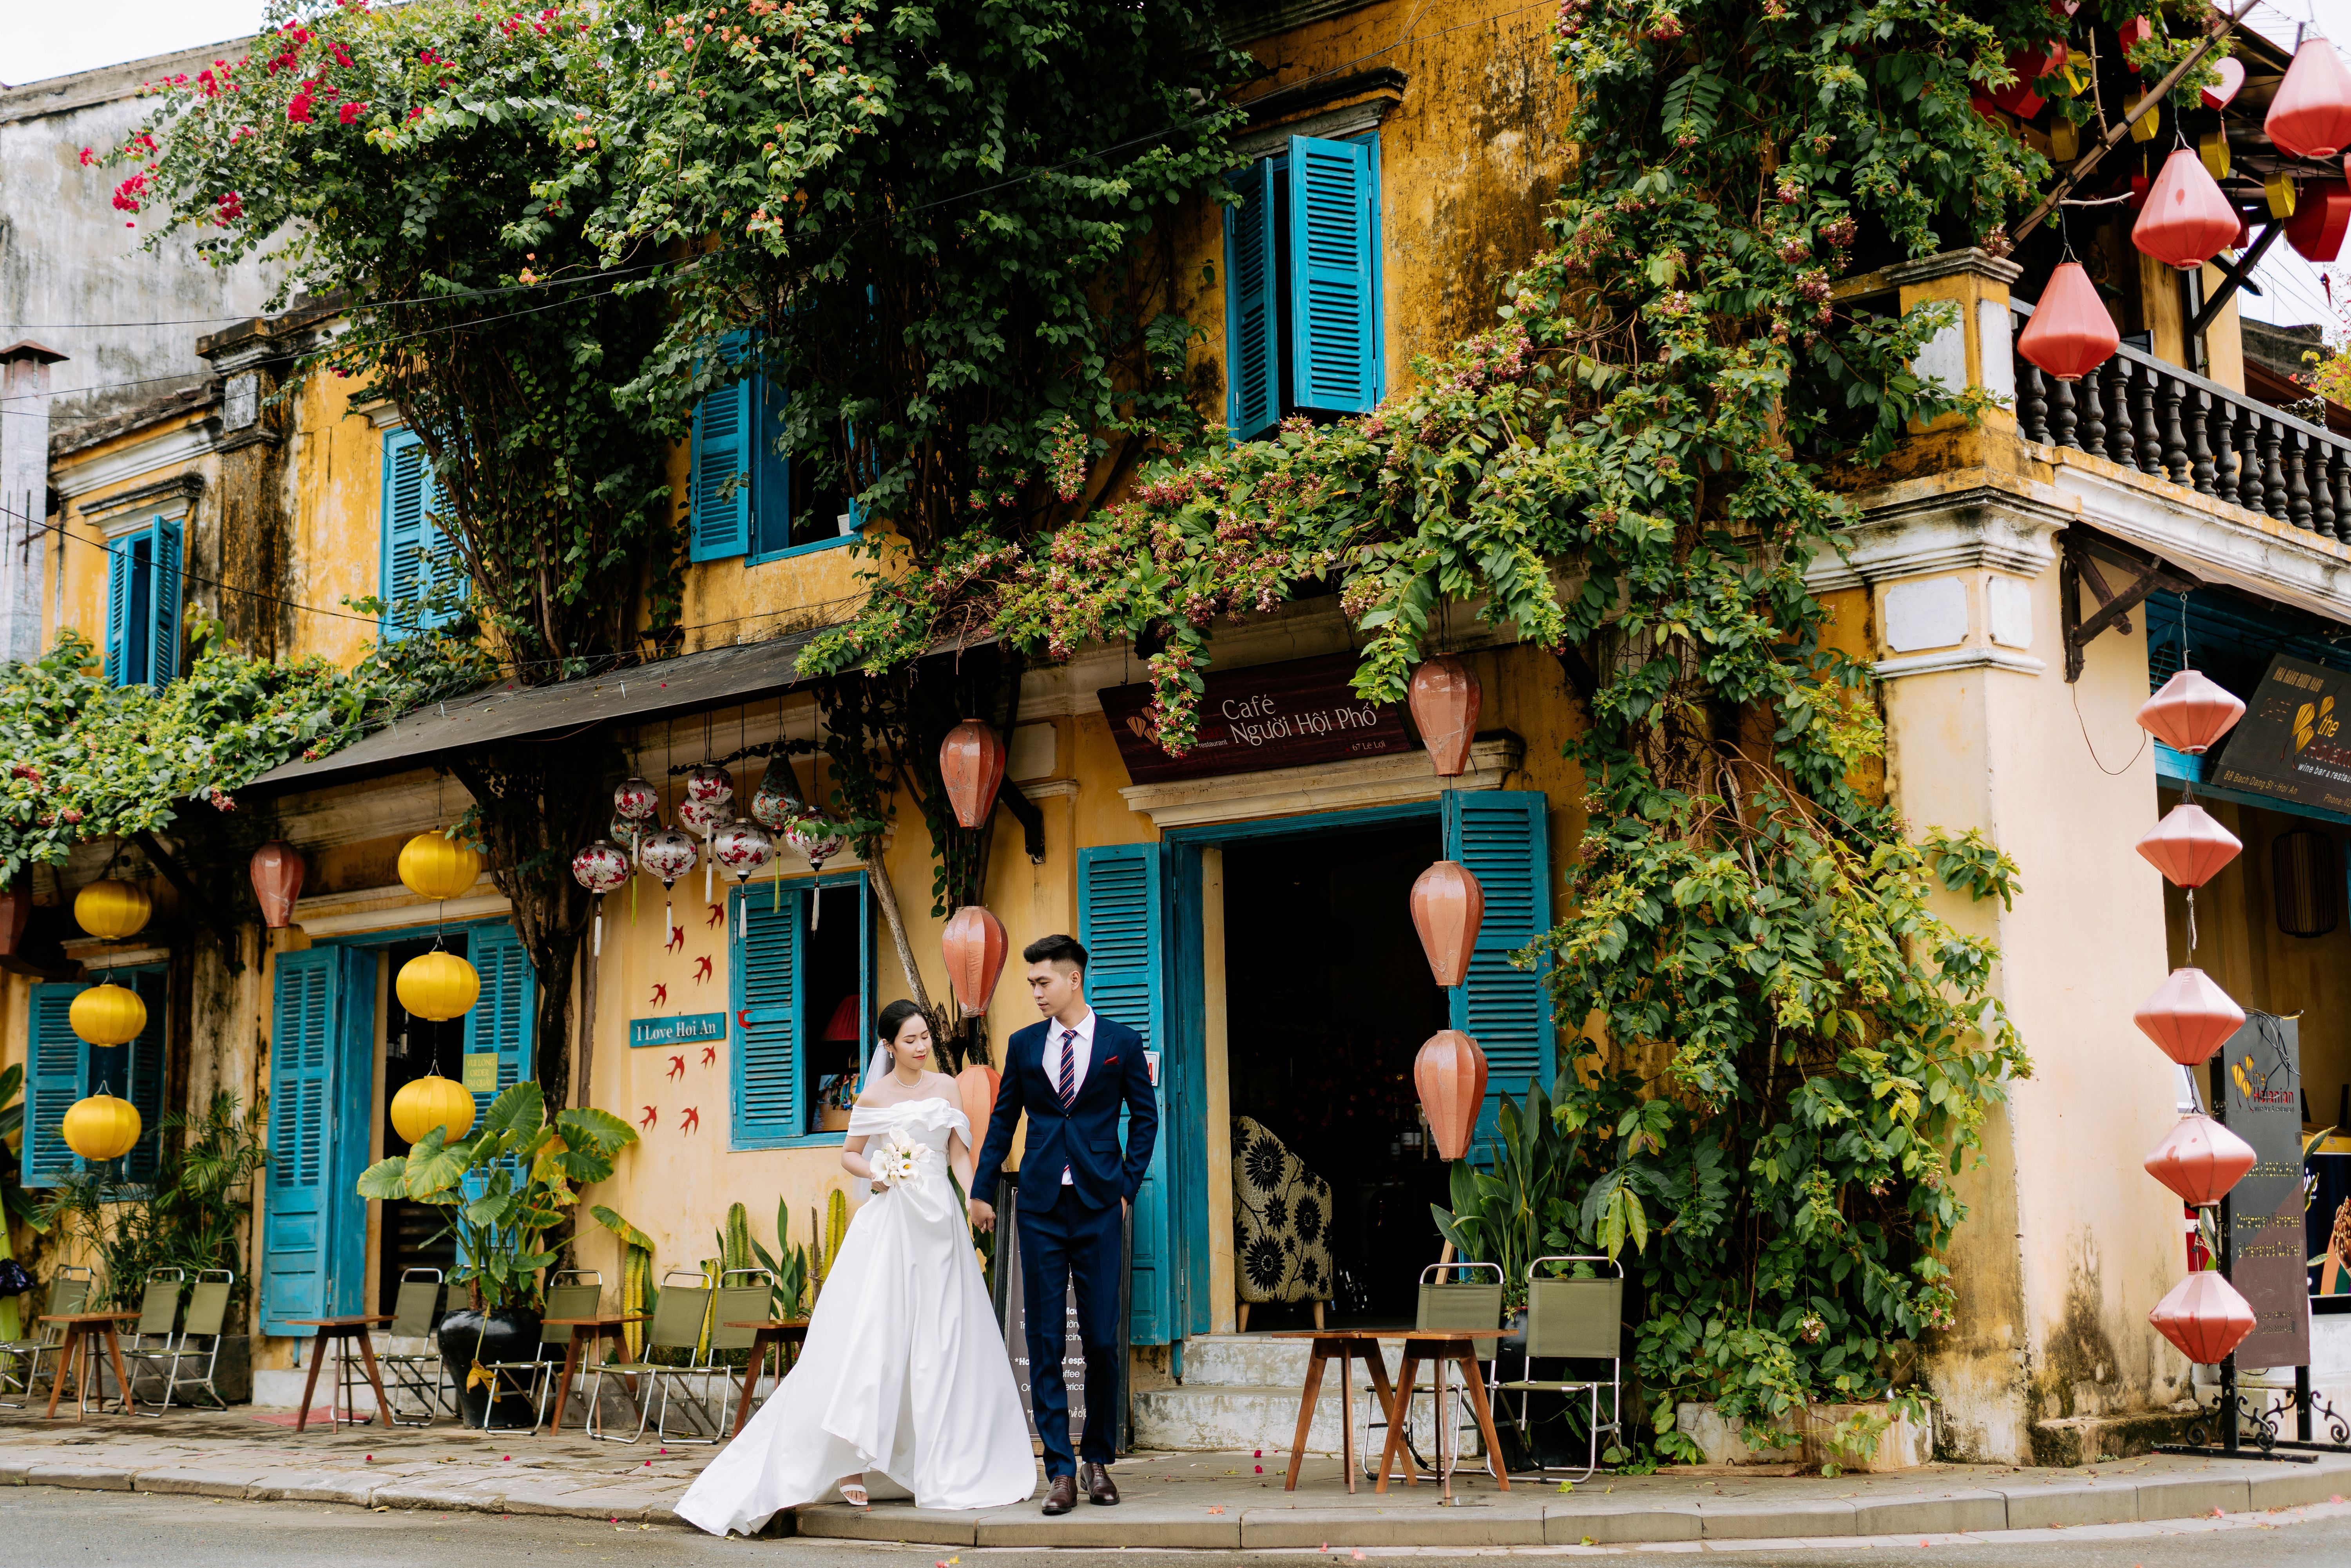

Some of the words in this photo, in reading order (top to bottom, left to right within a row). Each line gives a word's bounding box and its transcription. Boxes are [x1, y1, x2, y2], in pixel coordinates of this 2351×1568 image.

[1222, 694, 1276, 720] Café
[1230, 716, 1292, 746] Người
[1295, 711, 1332, 736] Hội
[1335, 702, 1377, 729] Phố
[2317, 714, 2339, 737] the
[1199, 739, 1228, 749] restaurant
[2304, 736, 2351, 768] Hoian
[2298, 763, 2313, 773] wine
[2314, 766, 2326, 776] bar
[2224, 770, 2234, 780] 88
[2233, 773, 2249, 785] Bach
[2249, 777, 2266, 790] Dang
[2266, 780, 2274, 789] St
[2277, 783, 2289, 793] Hoi
[2288, 785, 2298, 795] An
[2323, 793, 2344, 806] Phone:
[636, 1026, 642, 1041] I
[645, 1025, 673, 1040] Love
[676, 1021, 696, 1037] Hoi
[699, 1019, 716, 1034] An
[470, 1068, 489, 1077] ORDER
[2253, 1069, 2266, 1085] the
[2266, 1162, 2300, 1177] RESTAURANT
[2237, 1212, 2270, 1233] Contemporary
[2271, 1212, 2300, 1228] Vietnamese
[2244, 1241, 2277, 1257] International
[2278, 1241, 2300, 1257] Cuisines
[1063, 1370, 1080, 1378] ffee
